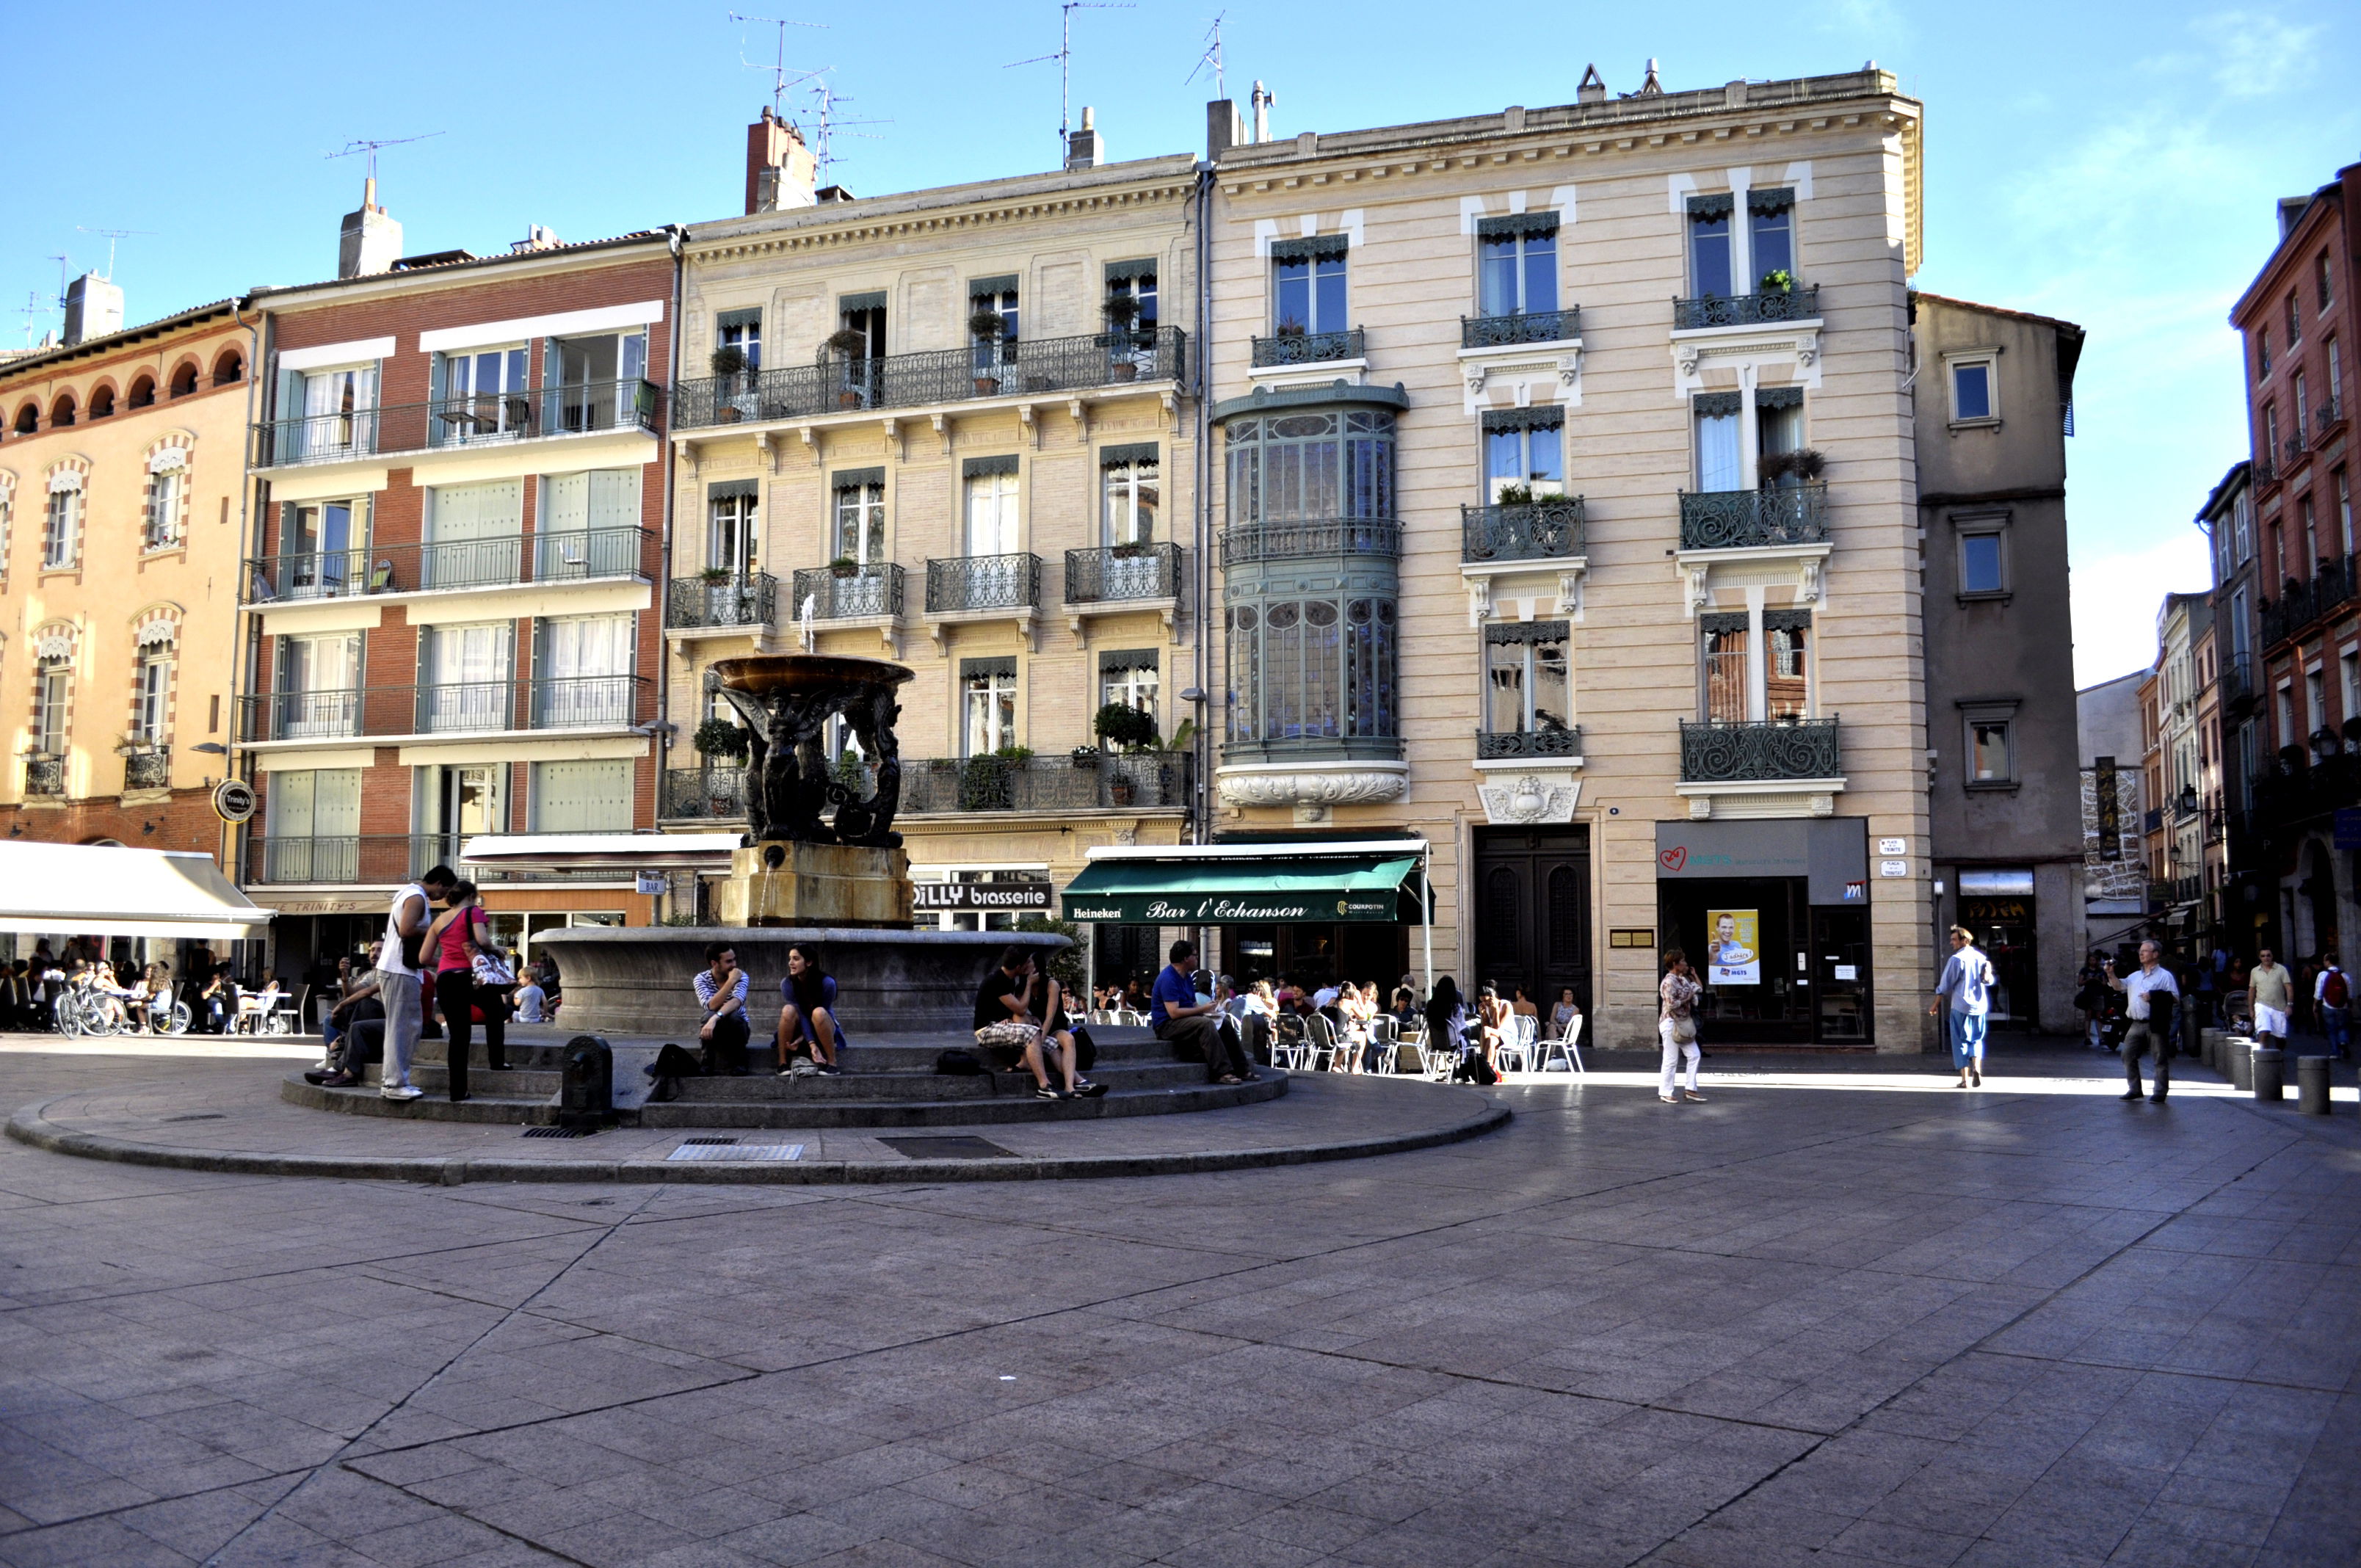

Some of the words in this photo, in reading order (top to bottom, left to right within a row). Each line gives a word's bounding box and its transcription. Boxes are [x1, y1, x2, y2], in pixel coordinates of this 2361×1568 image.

[227, 795, 250, 806] Trinity's
[1689, 854, 1733, 865] MGTS
[646, 882, 659, 891] BAR
[971, 886, 1045, 904] brasserie
[1073, 908, 1122, 918] Heineken
[1146, 901, 1190, 918] Bar
